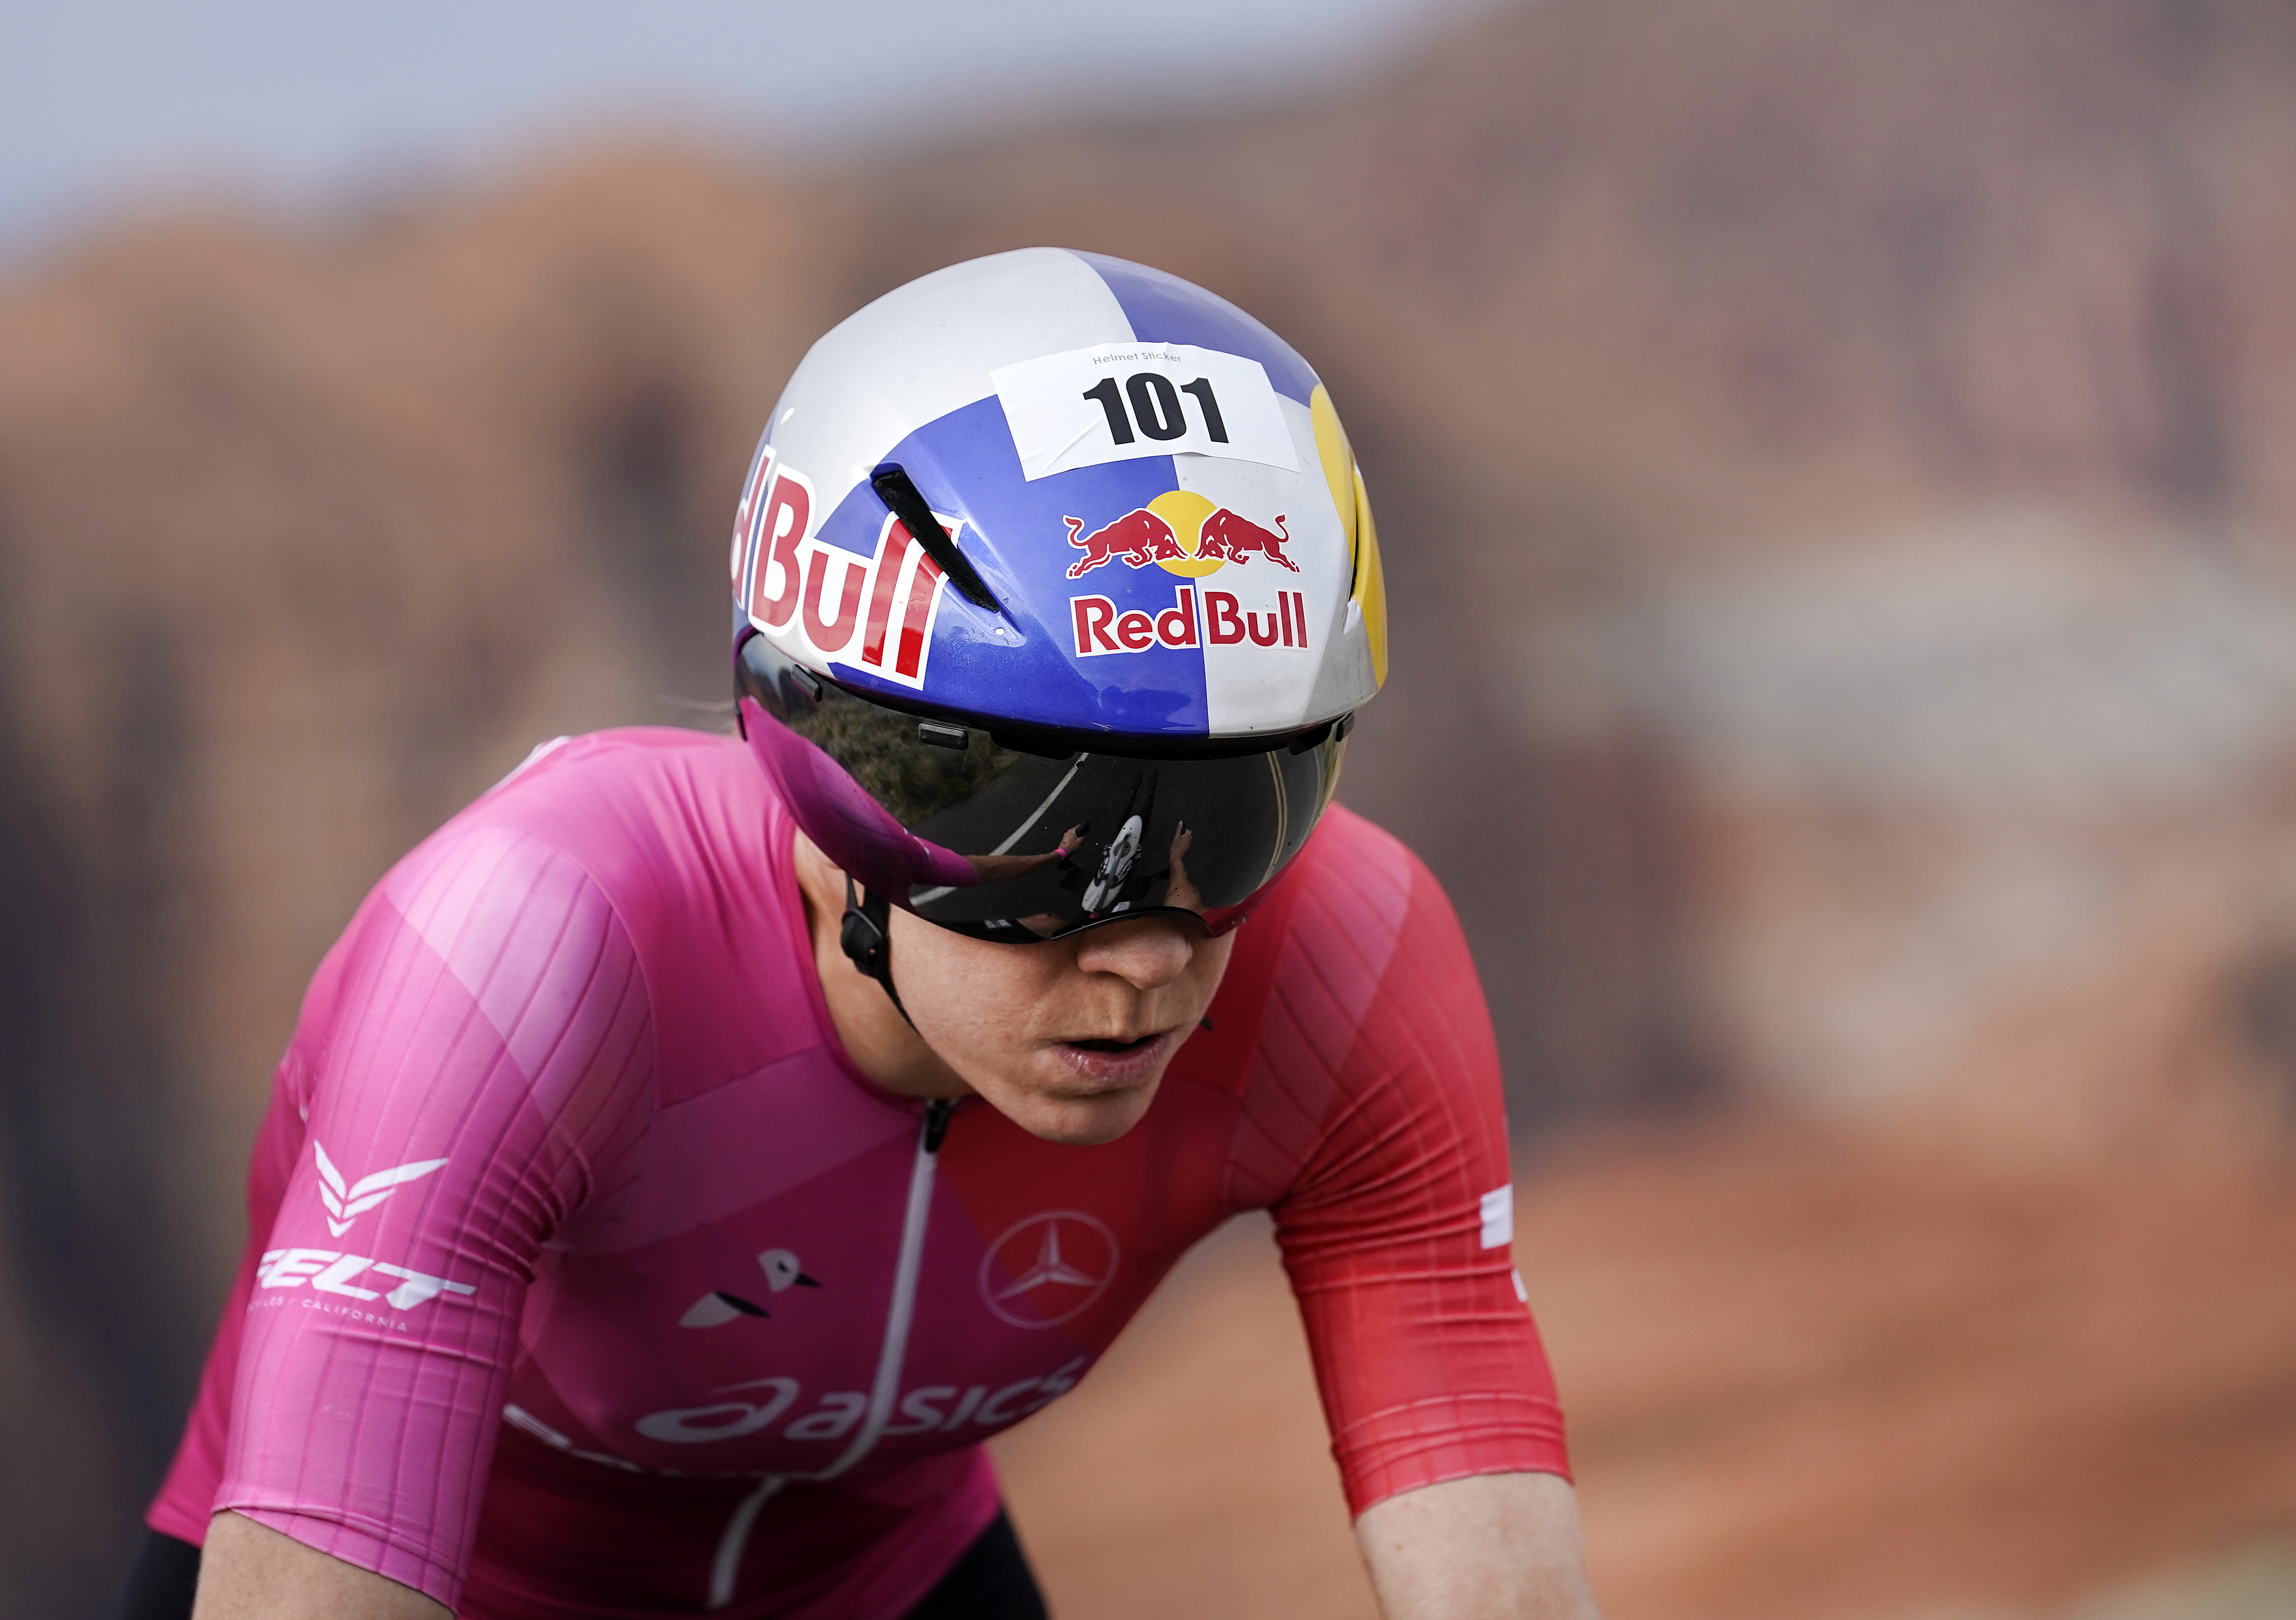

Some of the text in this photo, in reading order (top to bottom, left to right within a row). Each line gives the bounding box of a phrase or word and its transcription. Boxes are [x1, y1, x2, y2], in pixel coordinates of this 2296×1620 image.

[1093, 352, 1181, 364] Helmet Sticker
[1083, 373, 1229, 445] 101
[751, 473, 953, 679] Bull
[1073, 587, 1308, 654] Red Bull
[301, 1298, 407, 1332] CALIFORNIA
